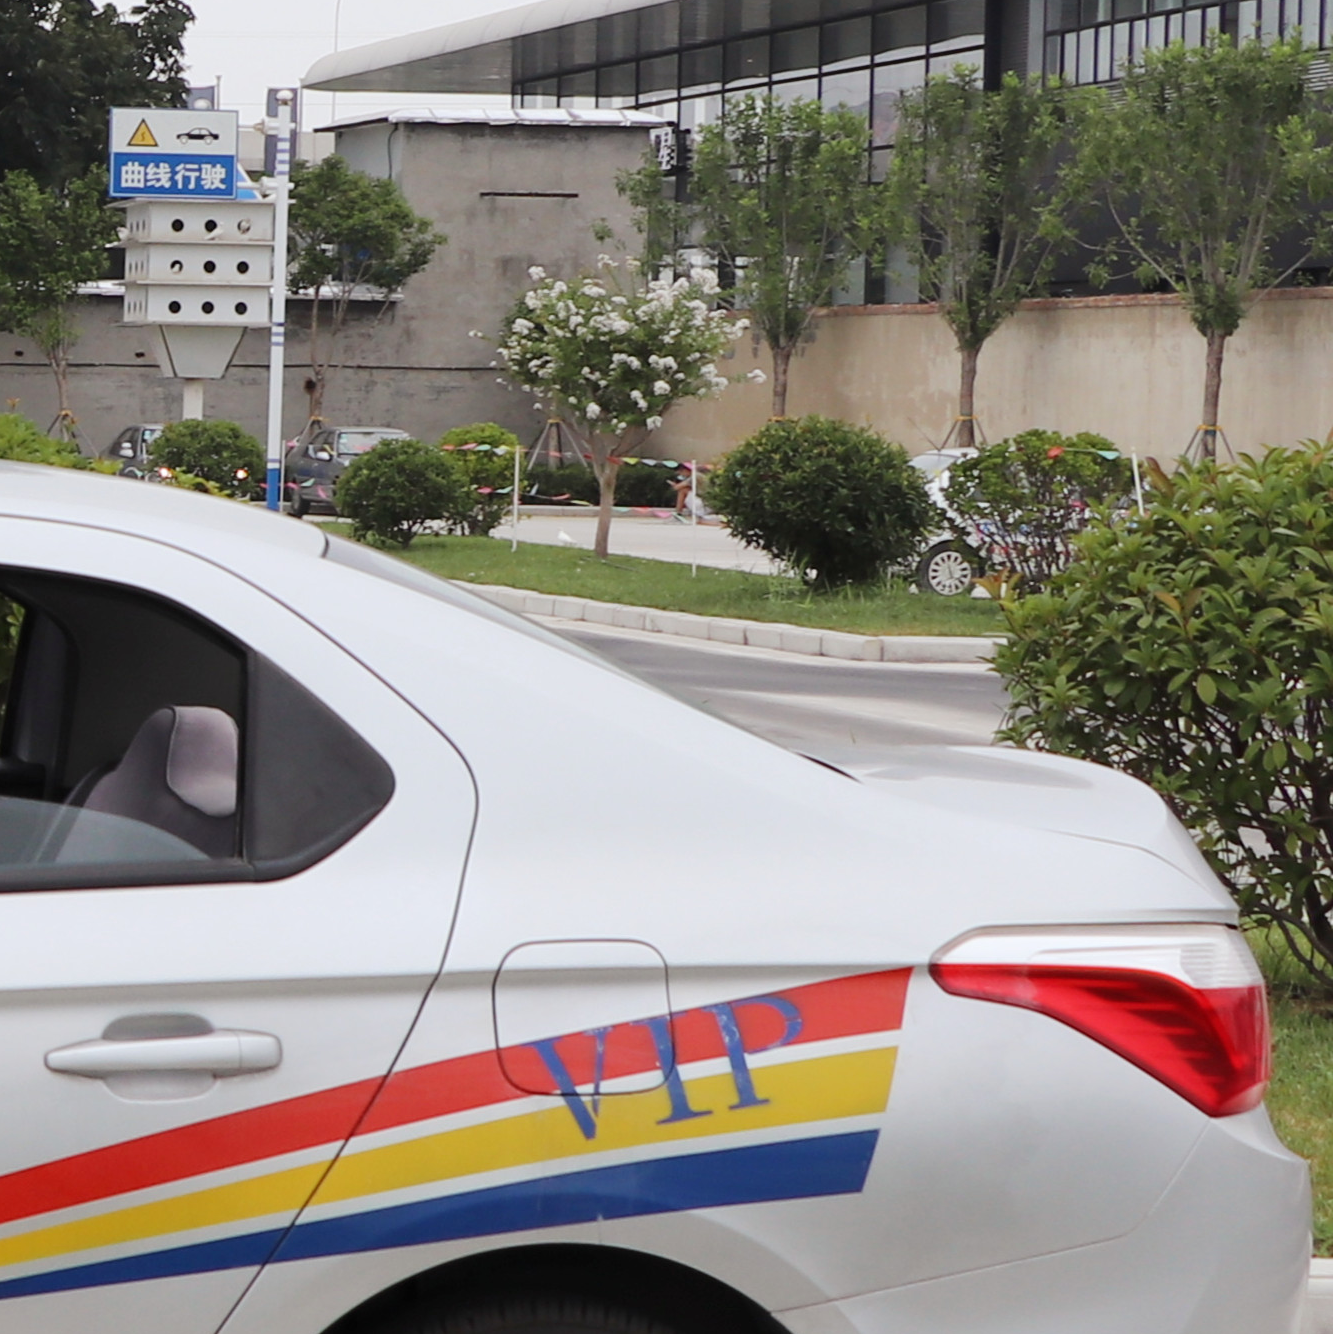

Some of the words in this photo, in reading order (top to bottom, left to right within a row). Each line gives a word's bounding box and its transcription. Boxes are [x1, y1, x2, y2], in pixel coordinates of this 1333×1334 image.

[120, 161, 227, 190] 曲线行驶
[521, 996, 803, 1141] VIP
